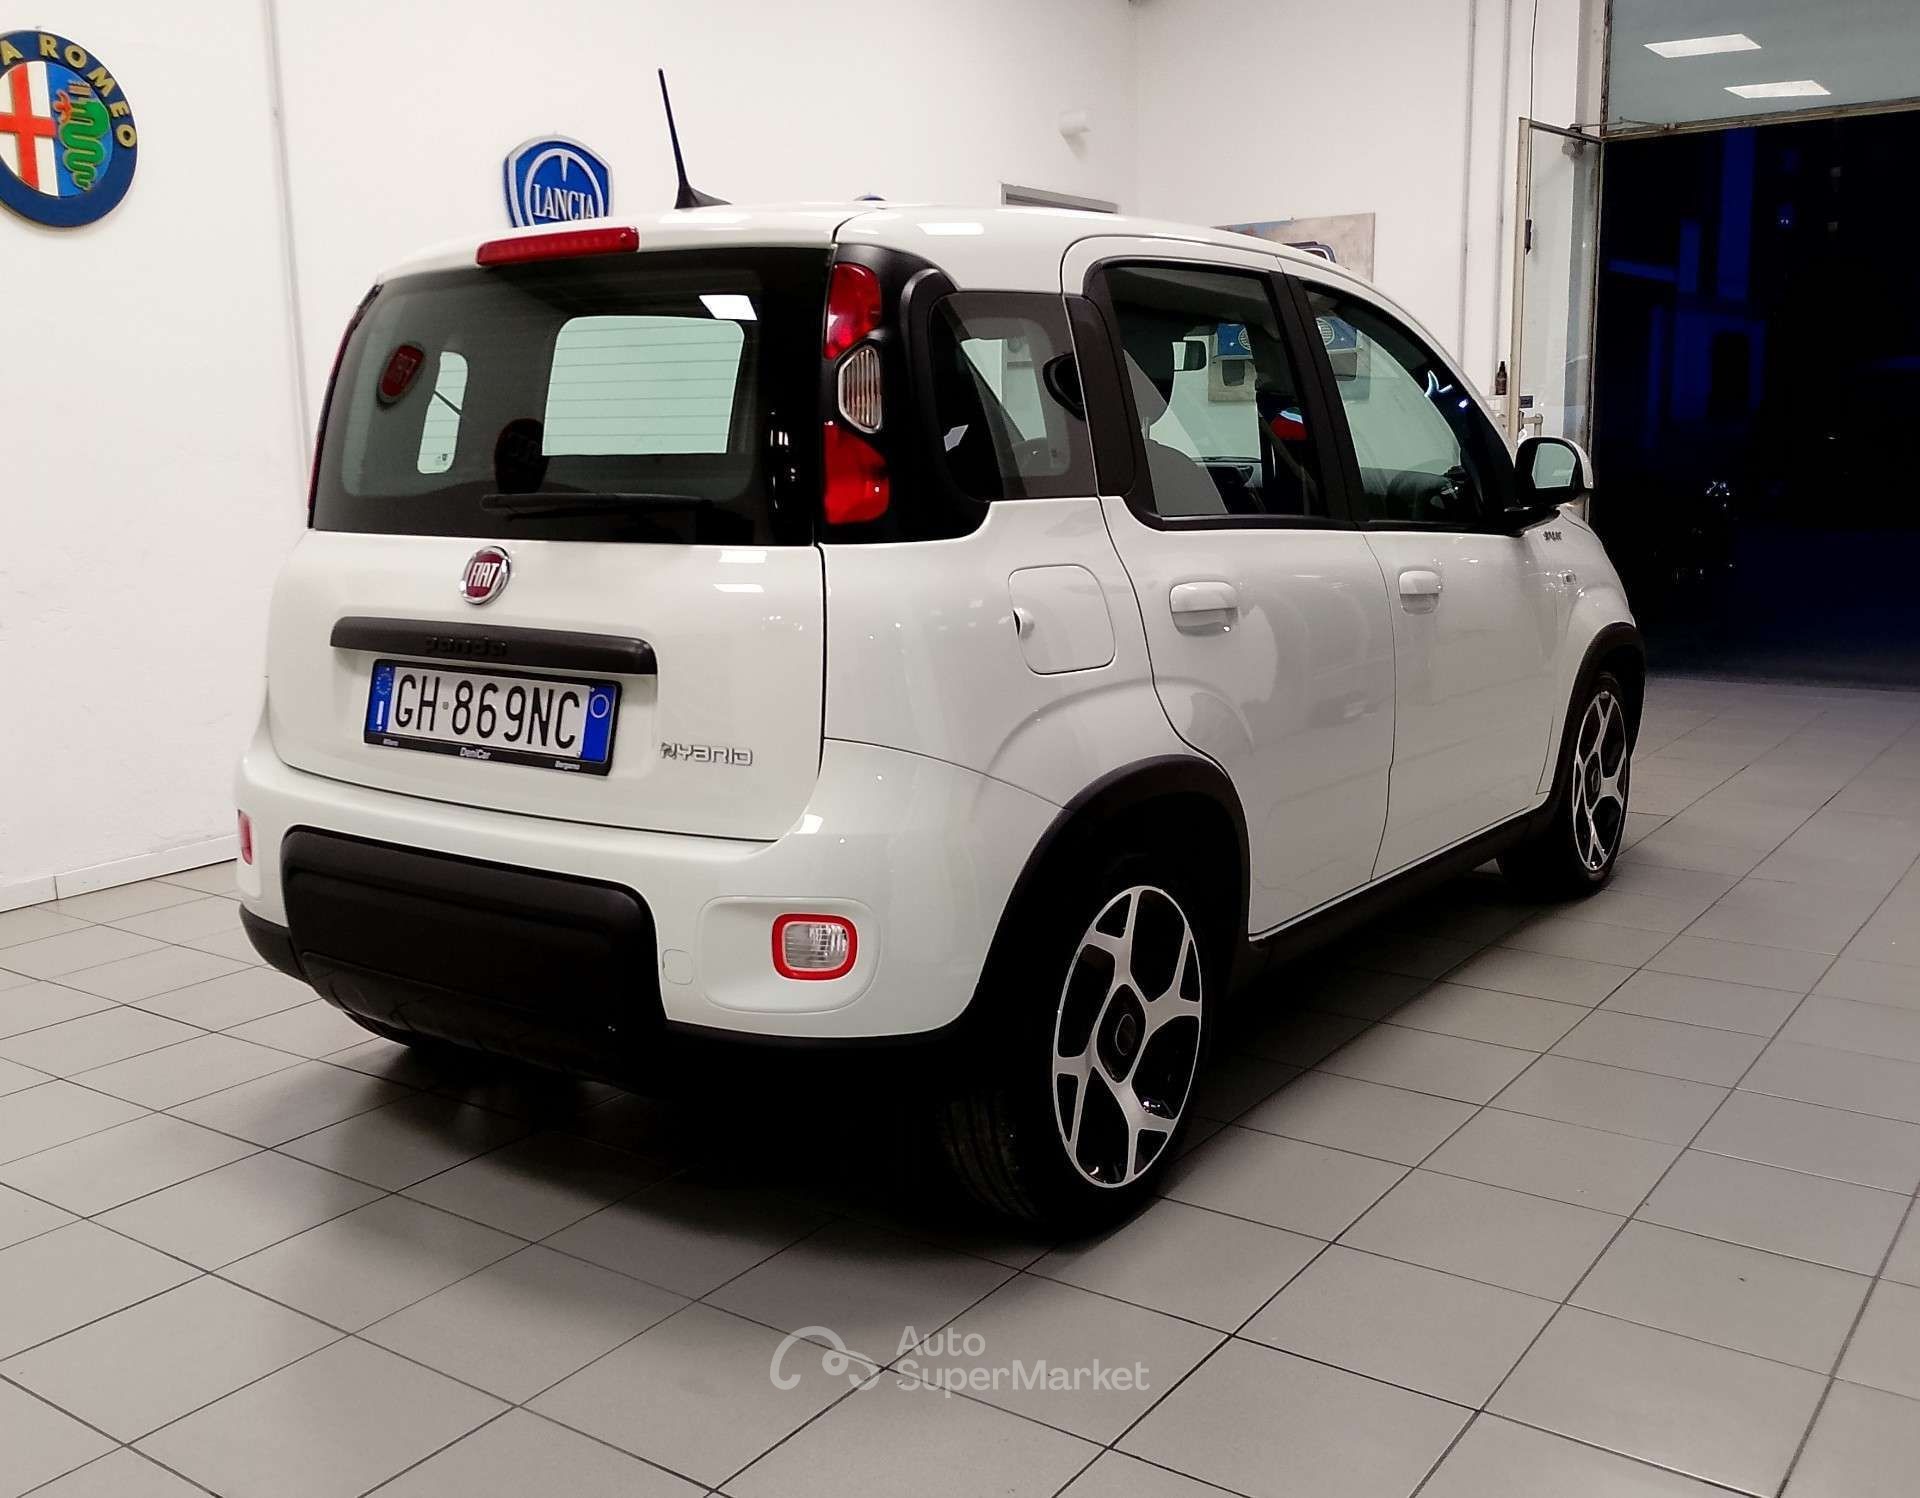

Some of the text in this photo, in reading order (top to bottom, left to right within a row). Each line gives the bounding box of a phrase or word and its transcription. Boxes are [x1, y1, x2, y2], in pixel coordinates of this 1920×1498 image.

[38, 33, 138, 148] ROMEO
[533, 183, 595, 220] LANCIA
[468, 562, 499, 588] FIAT
